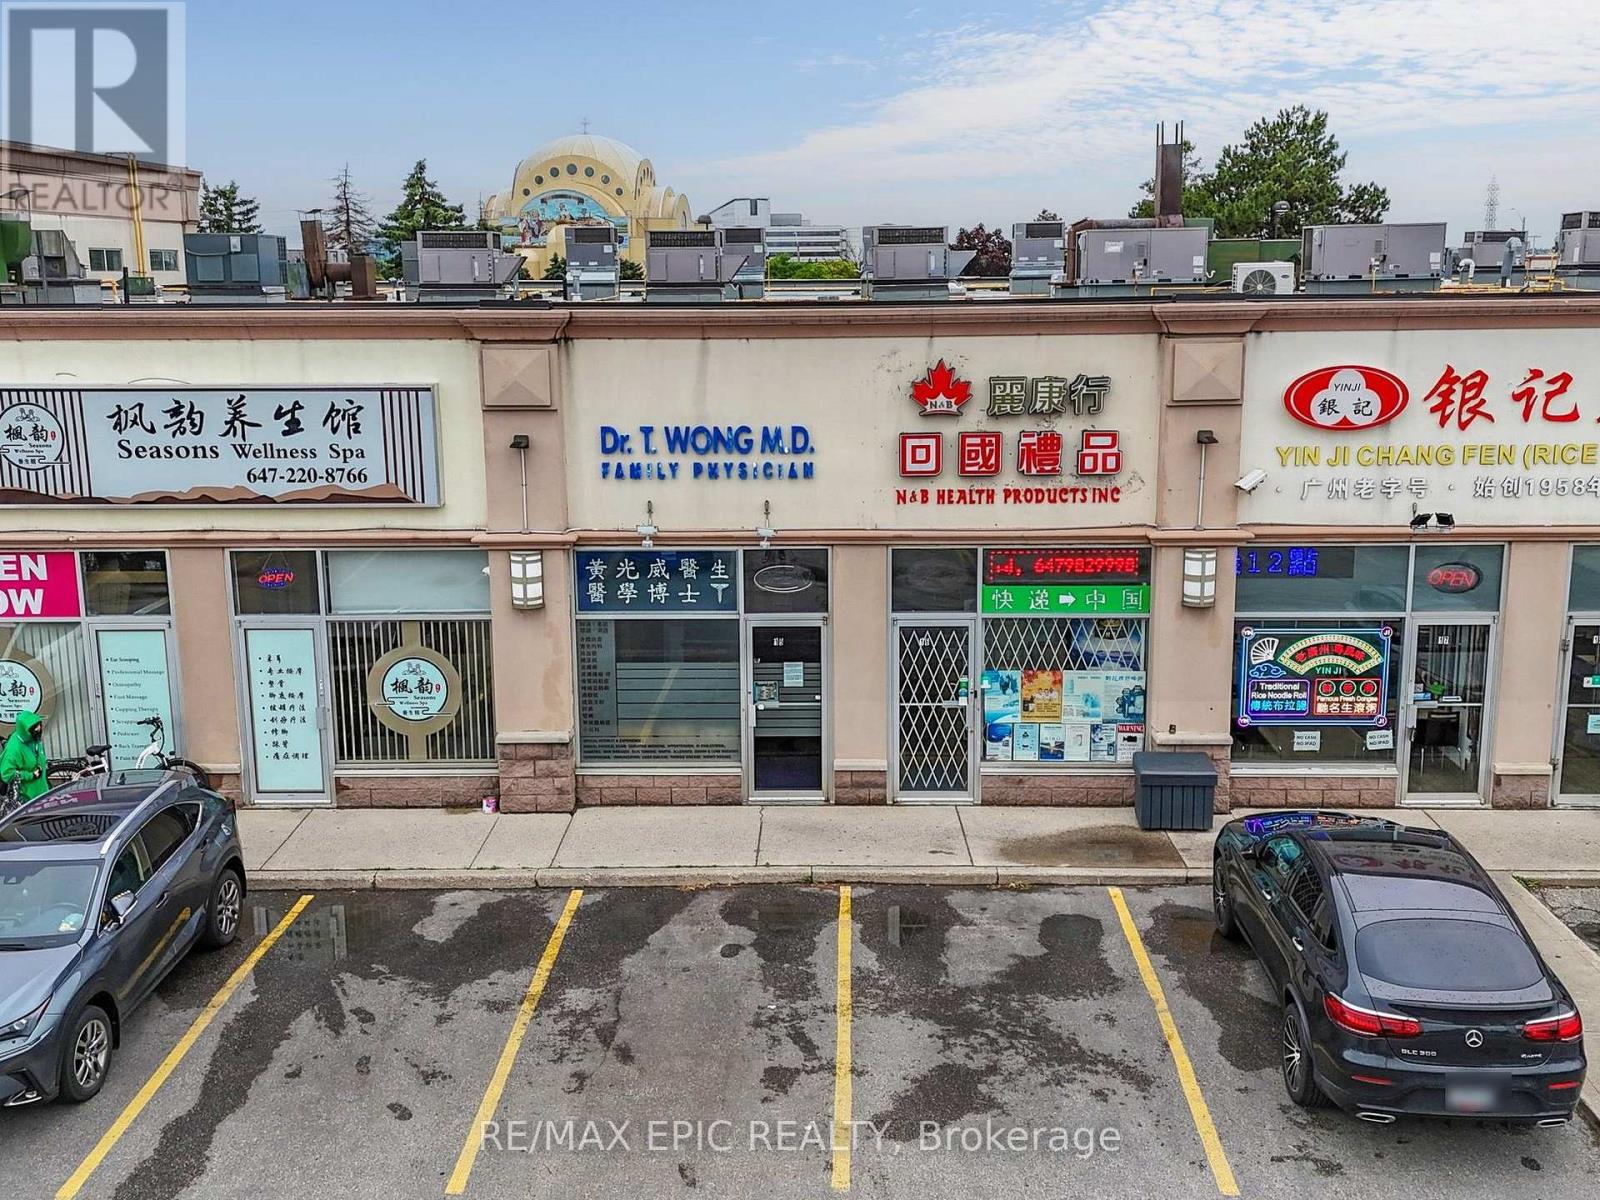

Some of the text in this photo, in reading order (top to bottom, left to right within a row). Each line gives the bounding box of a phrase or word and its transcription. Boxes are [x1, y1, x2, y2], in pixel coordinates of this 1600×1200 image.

[987, 374, 1112, 416] 麗康行
[1333, 382, 1361, 392] YINJI
[929, 400, 953, 409] N&B
[1318, 397, 1373, 417] 銀記
[106, 394, 365, 442] 枫韵养生馆
[117, 439, 366, 463] Seasons Wellness Spa
[600, 426, 815, 454] Dr. T. WONG M.D.
[899, 430, 1123, 477] 回國禮品
[1276, 443, 1599, 470] YIN JI CHANG FEN (RICE
[246, 467, 368, 484] 647-220-8766
[601, 462, 815, 480] FAMILY PHYSICIAN
[895, 486, 1121, 505] N&B HEALTH PRODUCTS INC
[1301, 477, 1430, 500] 广州老字号
[259, 572, 294, 584] OPEN
[1427, 568, 1477, 587] OPEN
[586, 582, 700, 604] 醫學博士
[992, 589, 1143, 611] 快递 中国
